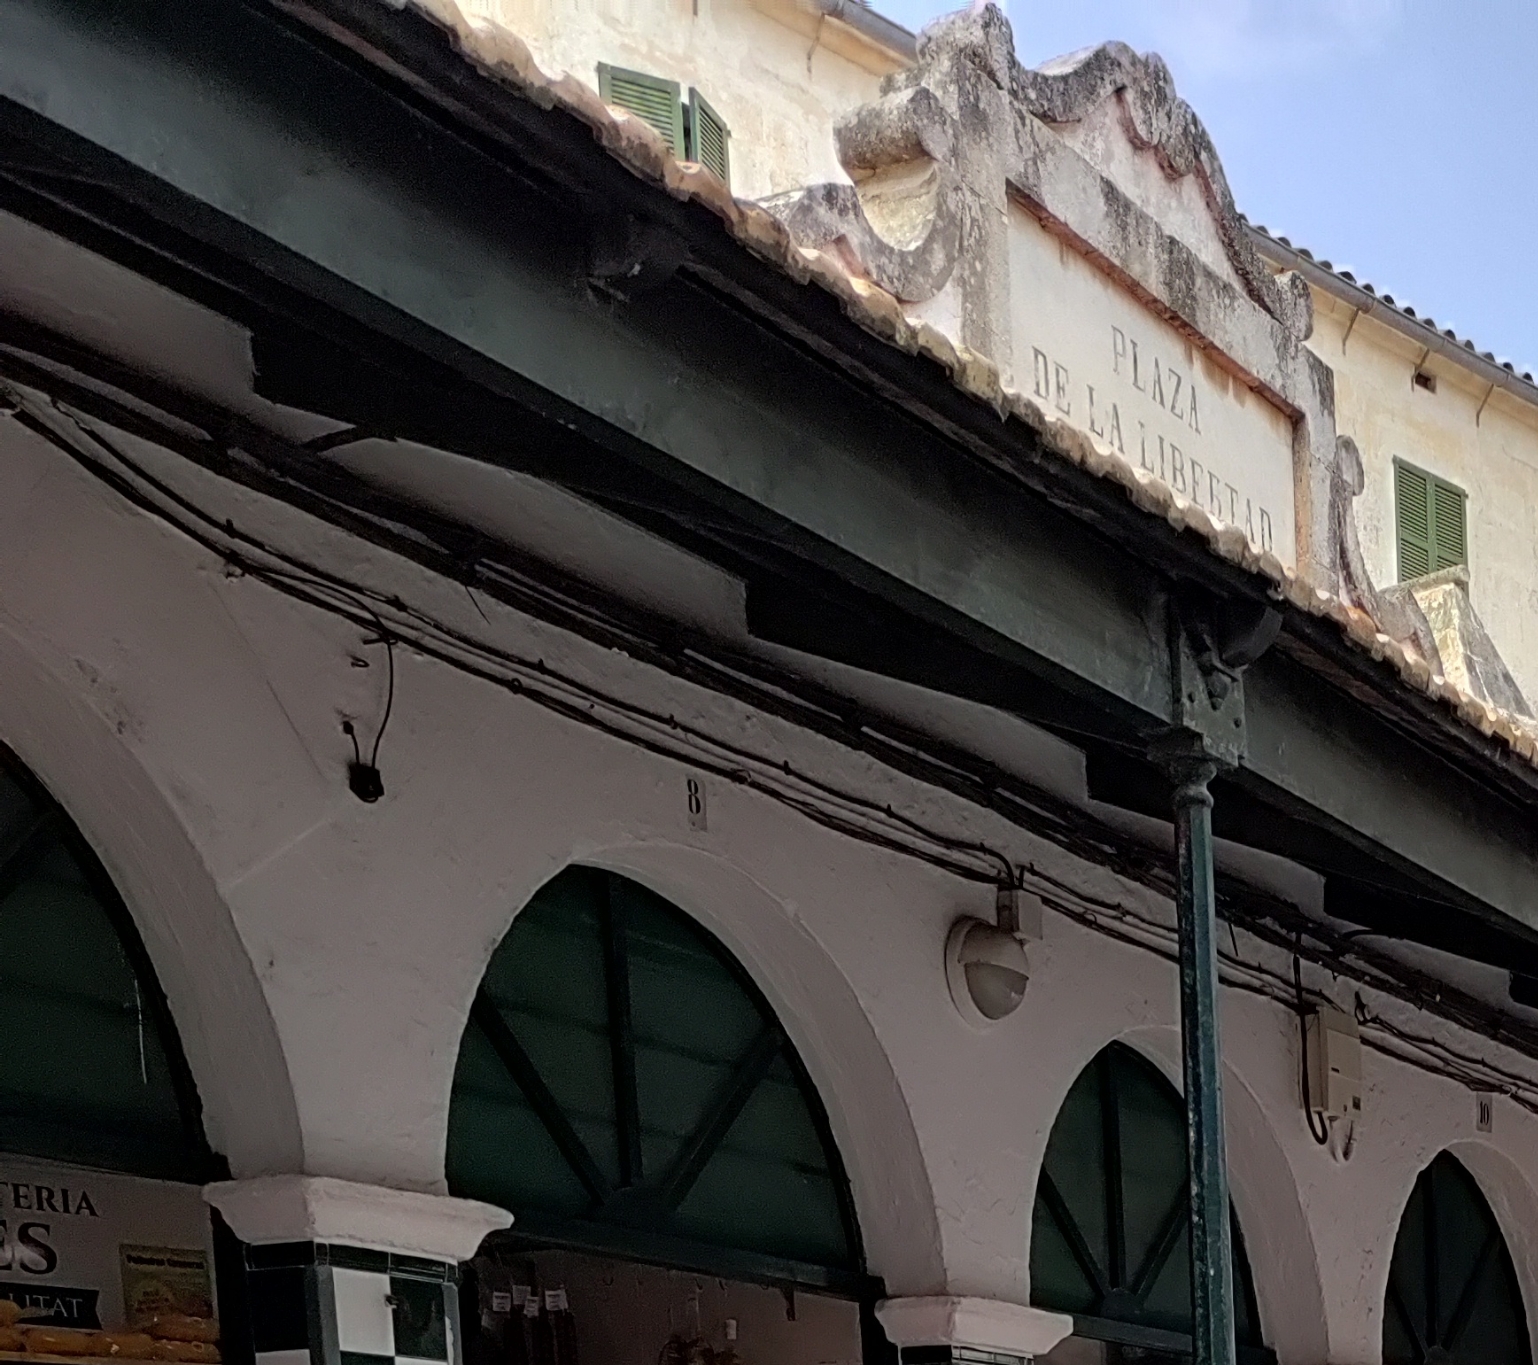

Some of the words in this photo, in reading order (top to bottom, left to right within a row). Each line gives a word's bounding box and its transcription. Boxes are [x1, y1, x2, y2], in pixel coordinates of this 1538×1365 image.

[1111, 324, 1201, 436] PLAZA
[1032, 345, 1071, 418] DE
[1086, 383, 1126, 456] LA
[1137, 419, 1274, 552] LIBERTAD
[687, 779, 701, 814] 8
[1479, 1100, 1490, 1125] 10
